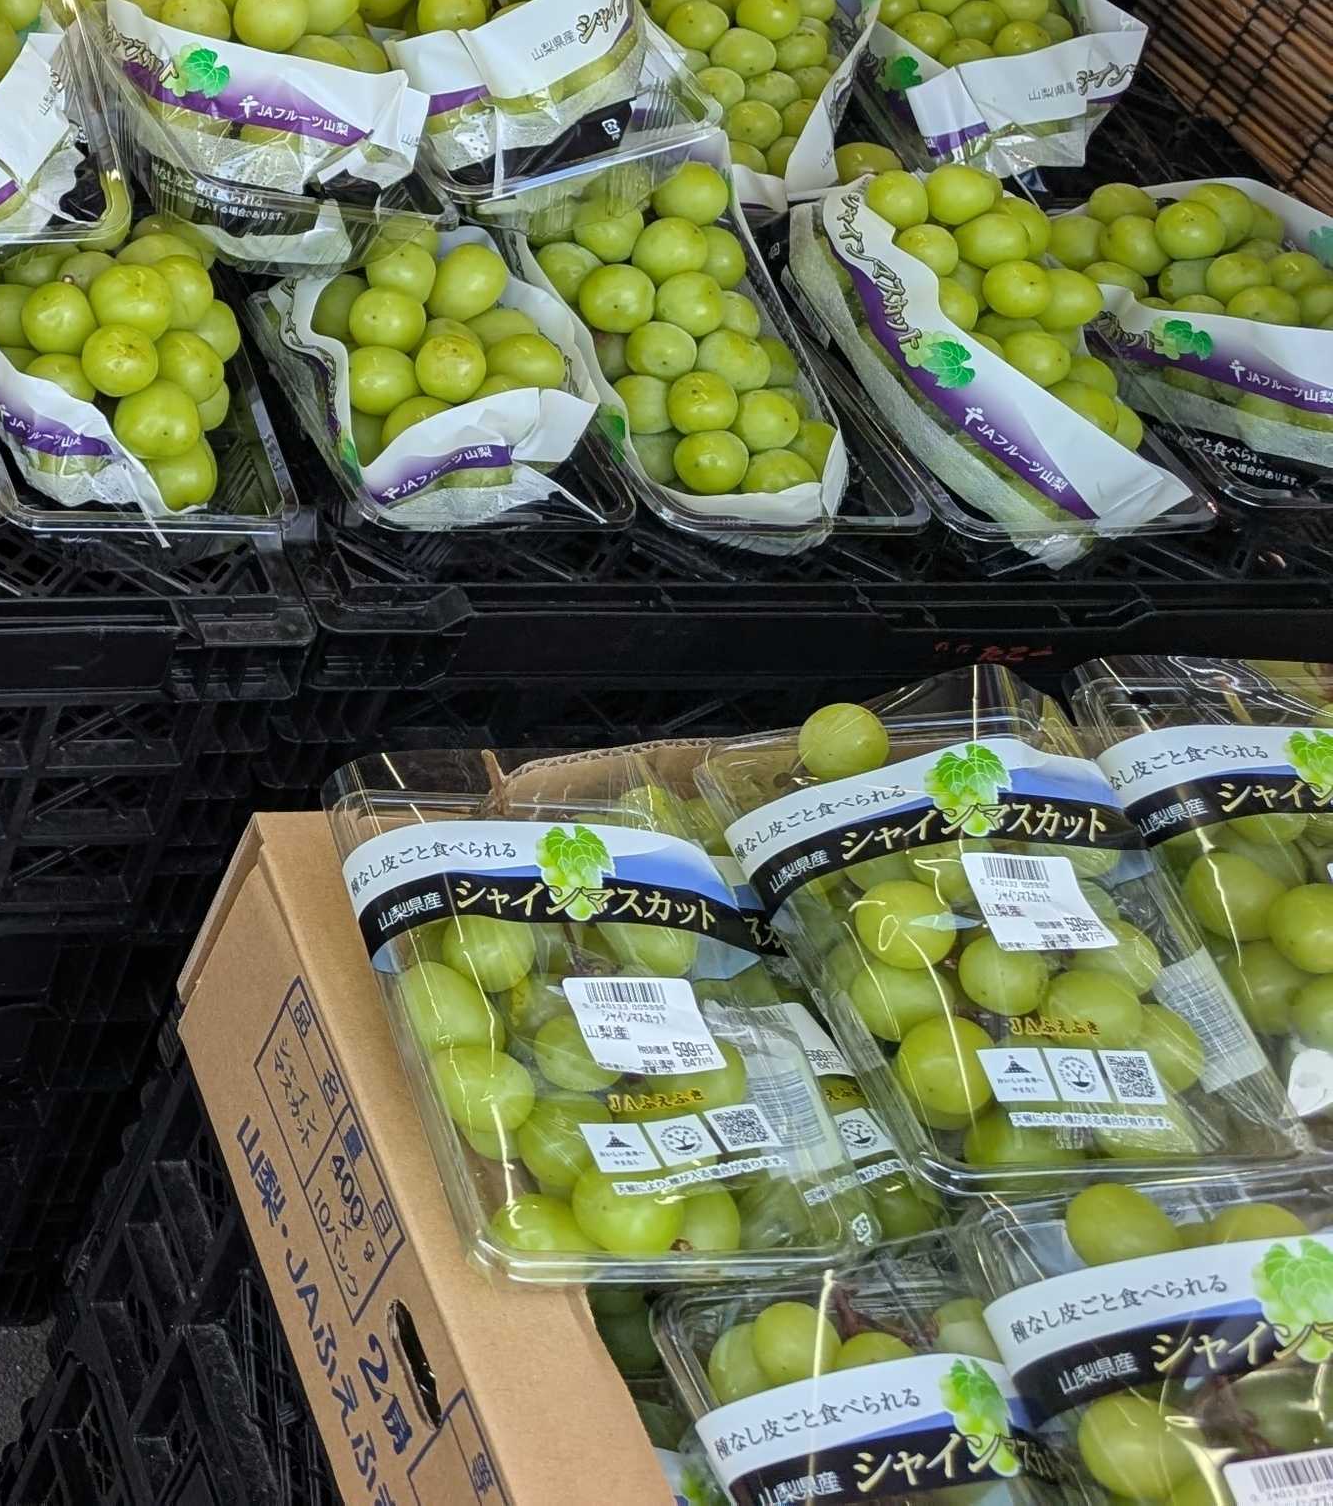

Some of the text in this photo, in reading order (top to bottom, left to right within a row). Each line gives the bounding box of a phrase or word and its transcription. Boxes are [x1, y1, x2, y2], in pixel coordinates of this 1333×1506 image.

[532, 31, 576, 61] 山梨県産
[257, 105, 349, 137] JAフルーツ山梨
[1246, 371, 1333, 404] JAフルーツ山梨
[401, 446, 493, 492] JAフルーツ山梨
[977, 422, 1069, 493] JAフルーツ山梨
[1137, 797, 1208, 837] 山梨県産
[769, 803, 1107, 894] 山梨県産 シャインマスカット
[376, 879, 716, 932] 山梨県産 シャインマスカット
[584, 1024, 630, 1040] 山梨産
[672, 1041, 714, 1057] 599円
[607, 1088, 705, 1113] JAふえふき
[1010, 1273, 1228, 1344] 種なし皮ごと食べられる
[1057, 1351, 1141, 1395] 山梨県産
[714, 1387, 921, 1462] 種なし皮ごと食べられる
[757, 1470, 845, 1506] 山梨県産
